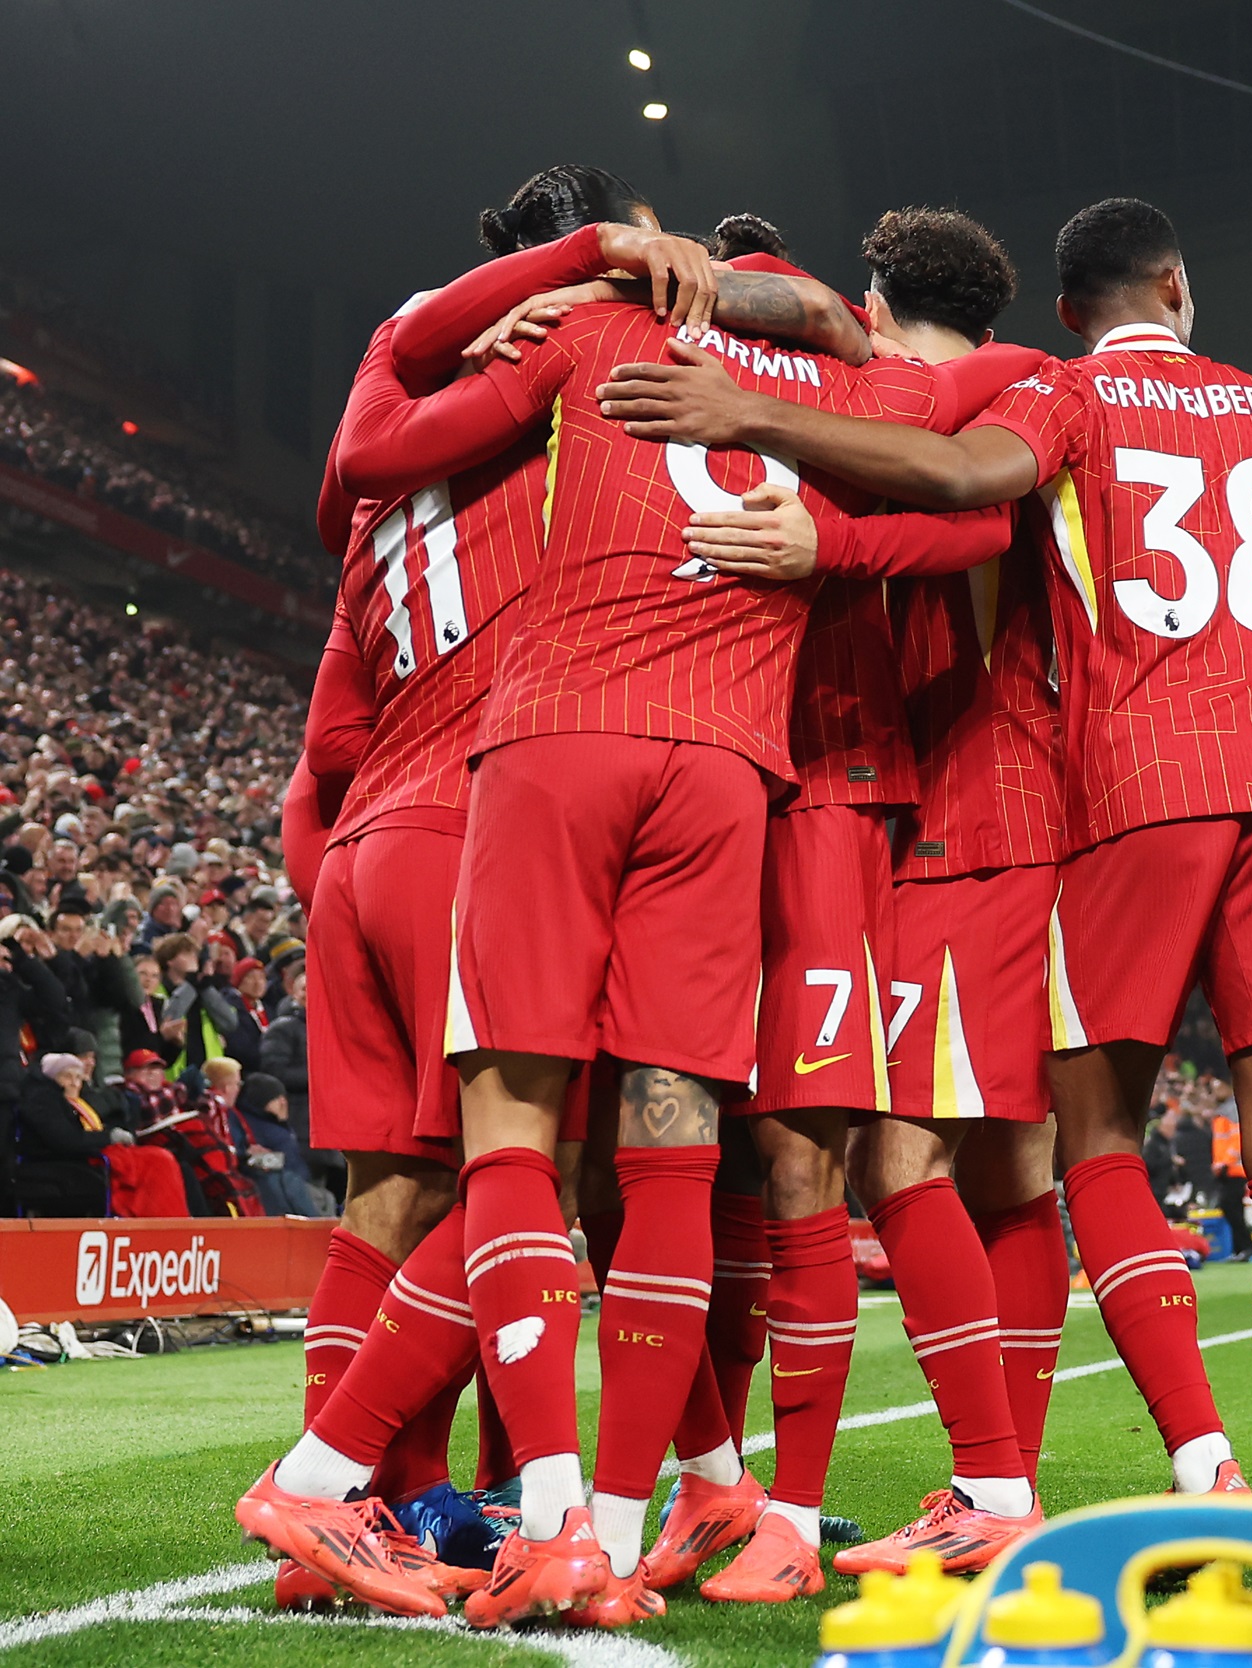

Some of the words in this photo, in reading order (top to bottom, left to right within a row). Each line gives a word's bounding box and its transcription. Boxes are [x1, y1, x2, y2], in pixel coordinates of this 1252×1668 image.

[371, 477, 470, 682] 11
[805, 968, 853, 1047] 7
[886, 980, 924, 1056] 7
[110, 1235, 221, 1309] Expedia
[541, 1290, 578, 1304] LFC
[1160, 1295, 1194, 1308] LFC
[617, 1329, 665, 1348] LFC
